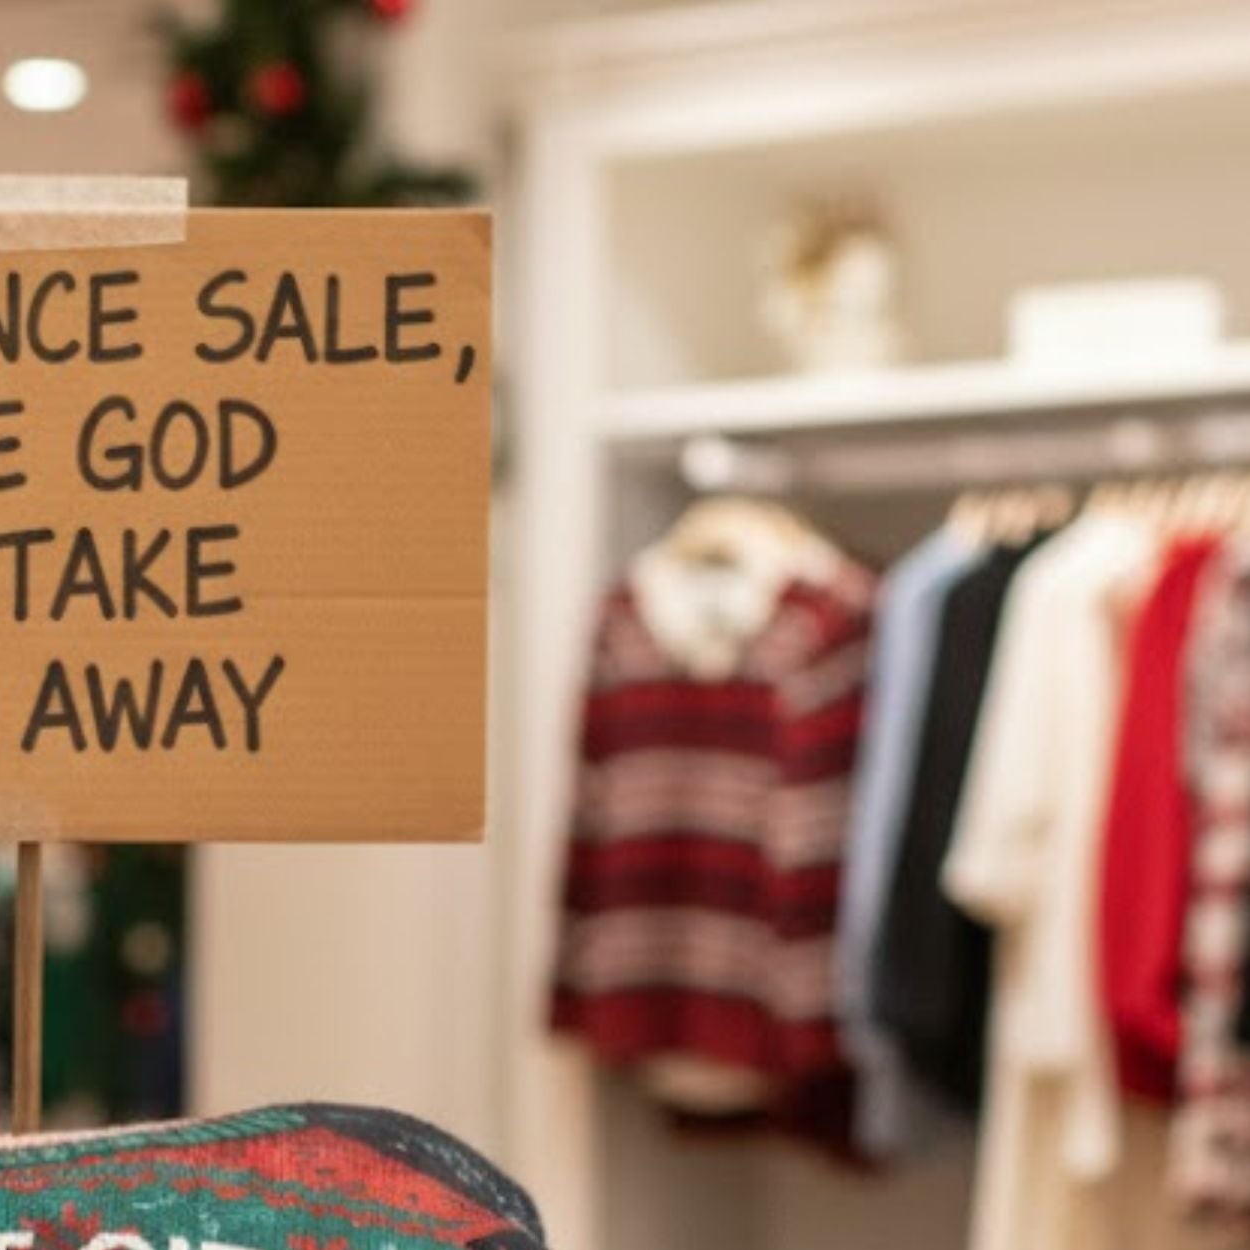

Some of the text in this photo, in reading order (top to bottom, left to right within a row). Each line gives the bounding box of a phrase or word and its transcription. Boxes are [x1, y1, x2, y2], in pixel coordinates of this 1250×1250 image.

[194, 271, 477, 384] SALE,
[75, 396, 278, 491] GOD
[20, 655, 285, 753] AWAY
